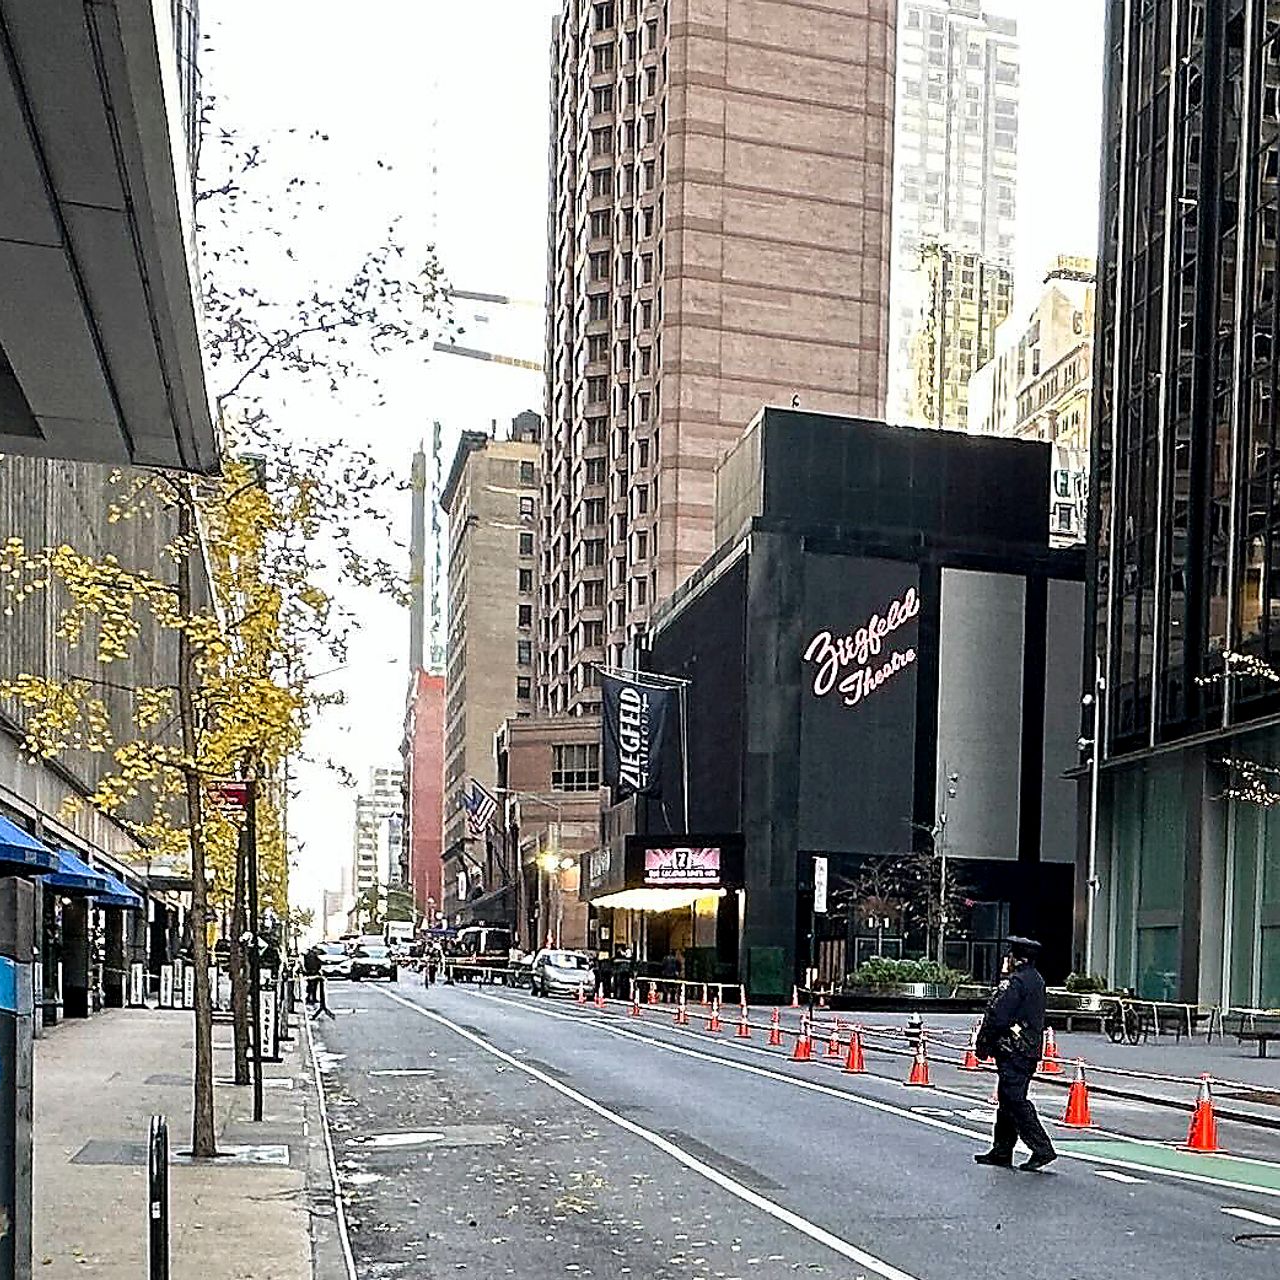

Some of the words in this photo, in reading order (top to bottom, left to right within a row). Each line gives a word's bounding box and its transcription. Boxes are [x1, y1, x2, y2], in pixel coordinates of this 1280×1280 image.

[803, 587, 920, 695] Ziegfeld
[838, 648, 916, 705] Theatre
[619, 687, 641, 789] ZIEGFELD
